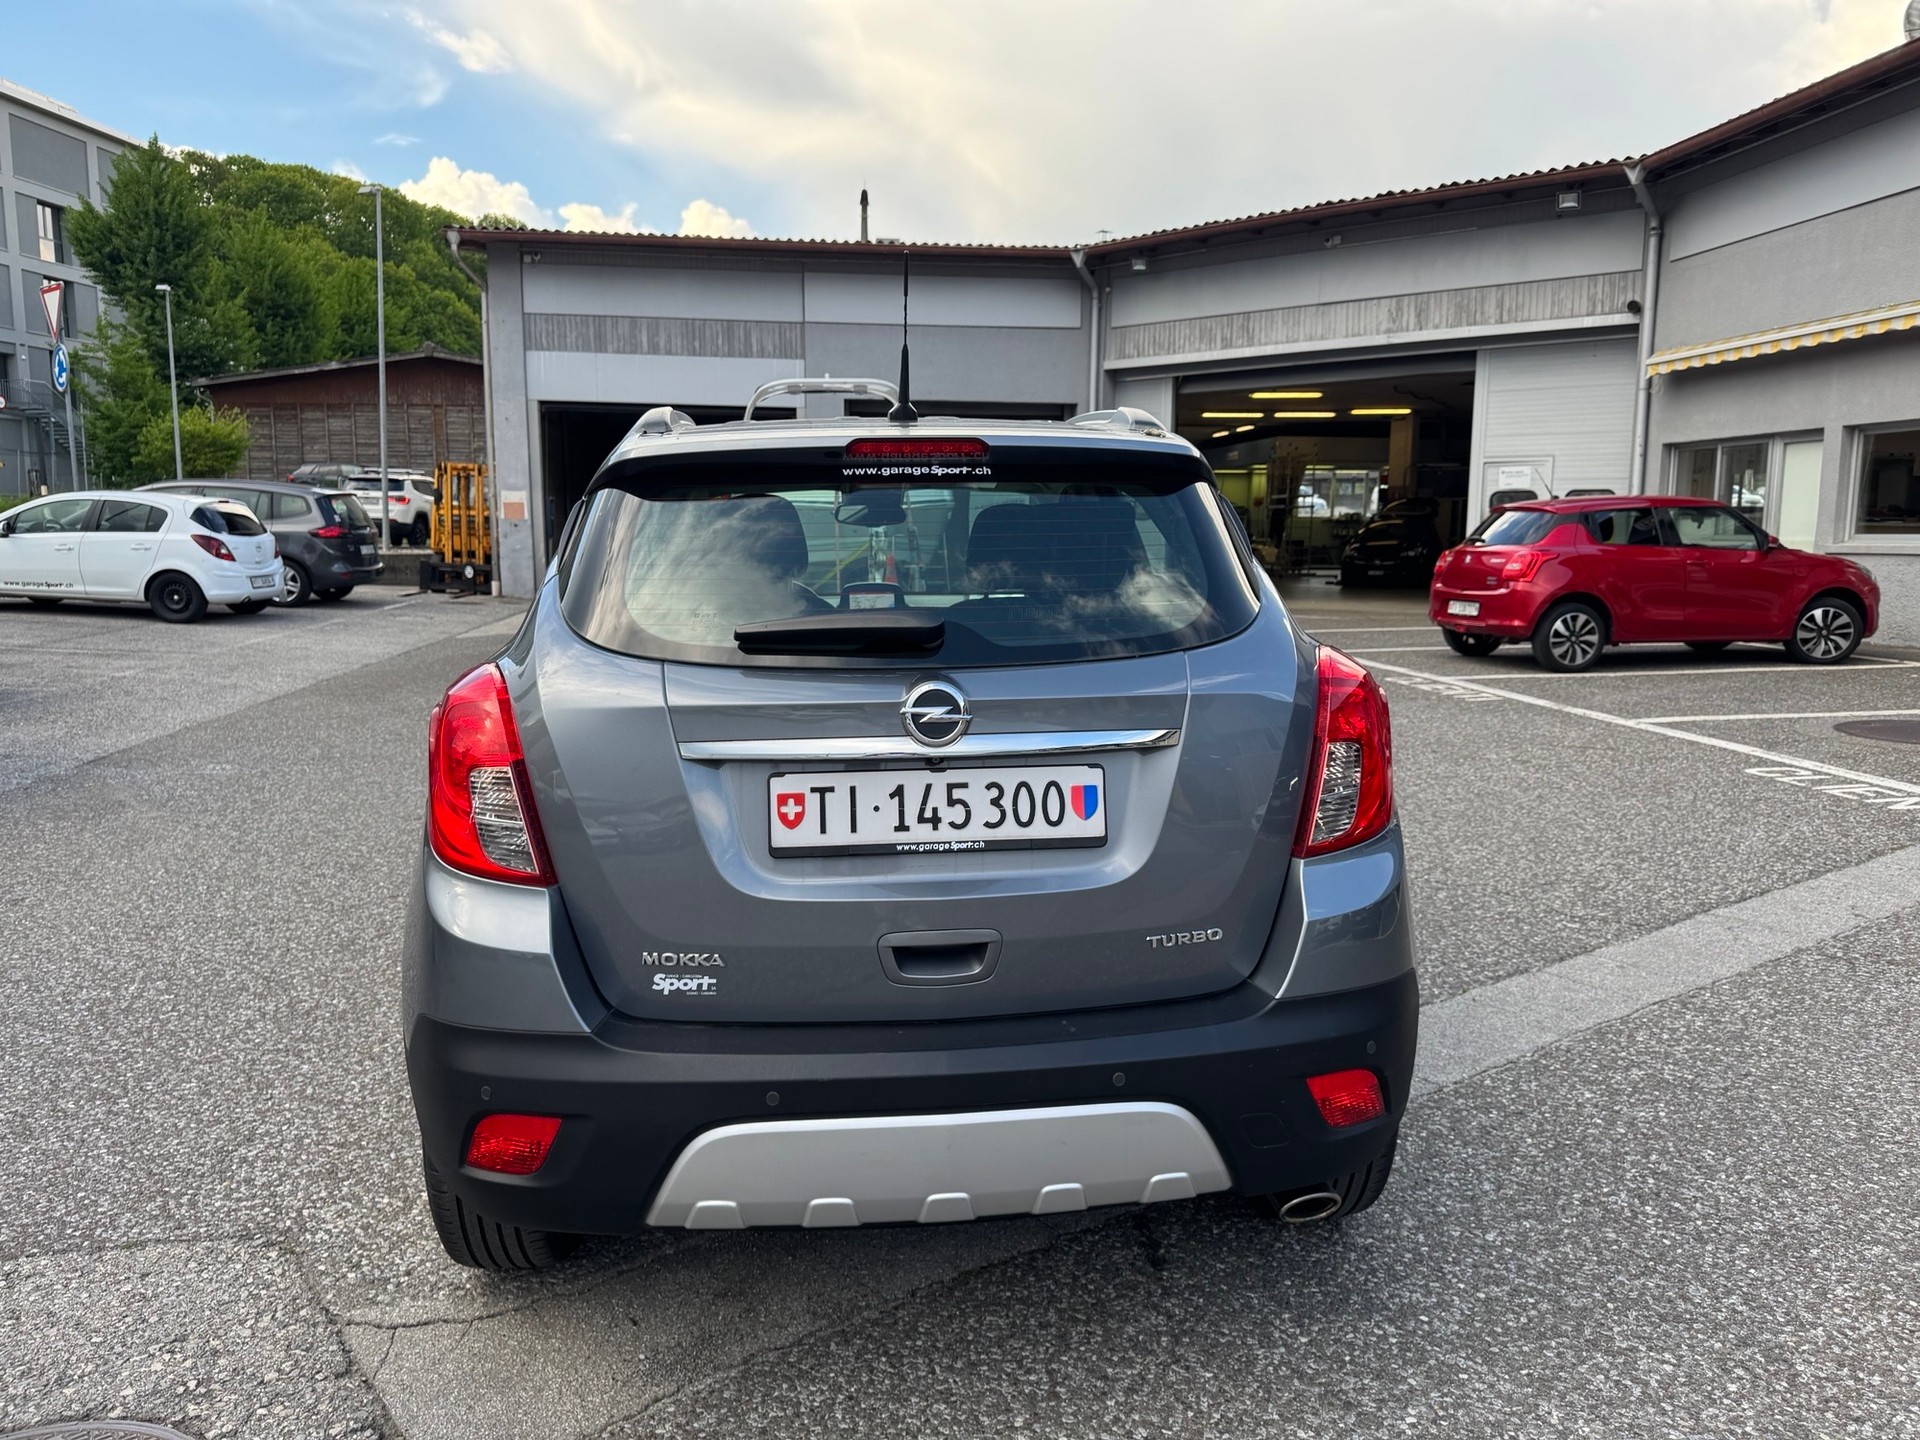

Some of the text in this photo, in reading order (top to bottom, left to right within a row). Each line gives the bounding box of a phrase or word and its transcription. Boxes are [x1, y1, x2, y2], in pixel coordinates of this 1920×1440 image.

[1146, 927, 1223, 949] TURBO
[641, 951, 726, 967] MOKKA
[652, 973, 717, 996] Sport
